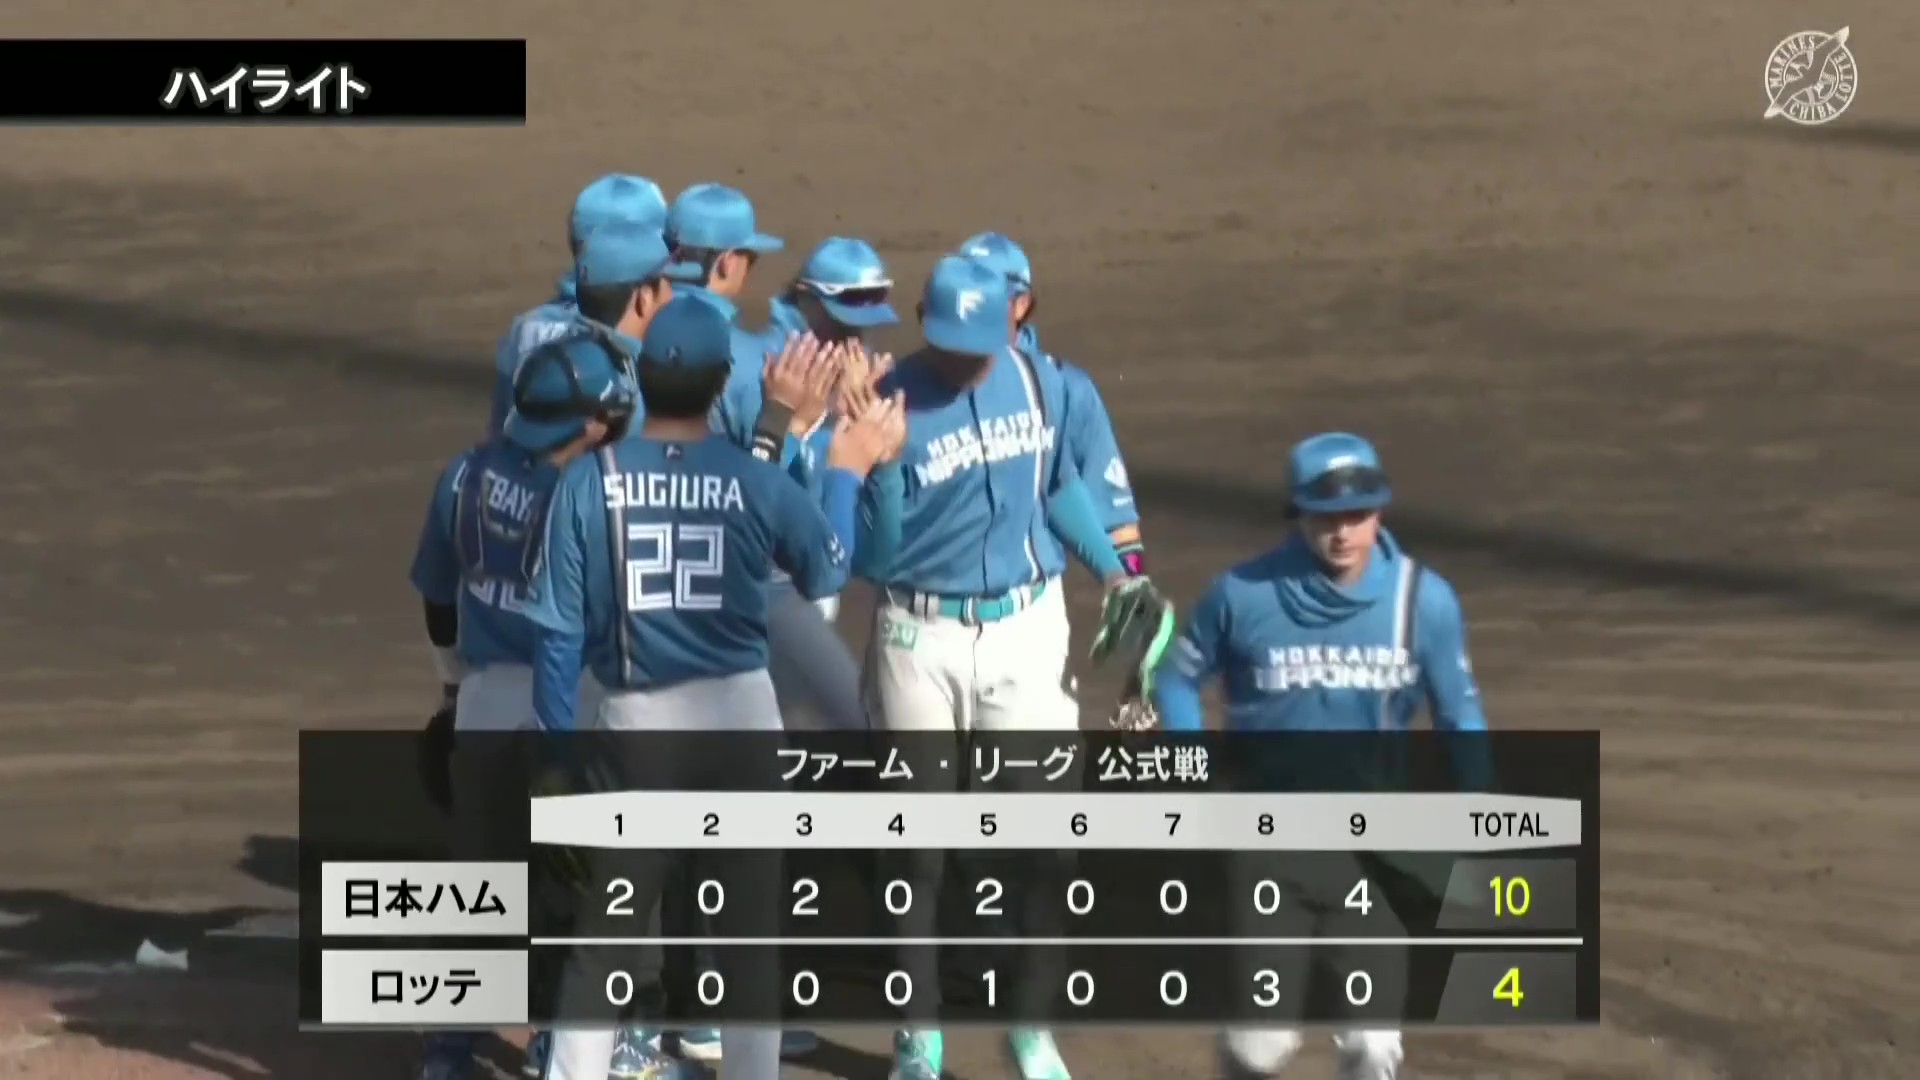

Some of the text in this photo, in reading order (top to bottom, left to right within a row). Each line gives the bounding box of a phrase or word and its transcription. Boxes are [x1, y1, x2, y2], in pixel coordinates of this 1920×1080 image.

[604, 472, 744, 512] SUGIURA
[627, 522, 724, 611] 22
[1268, 645, 1410, 667] HOKKAIDO
